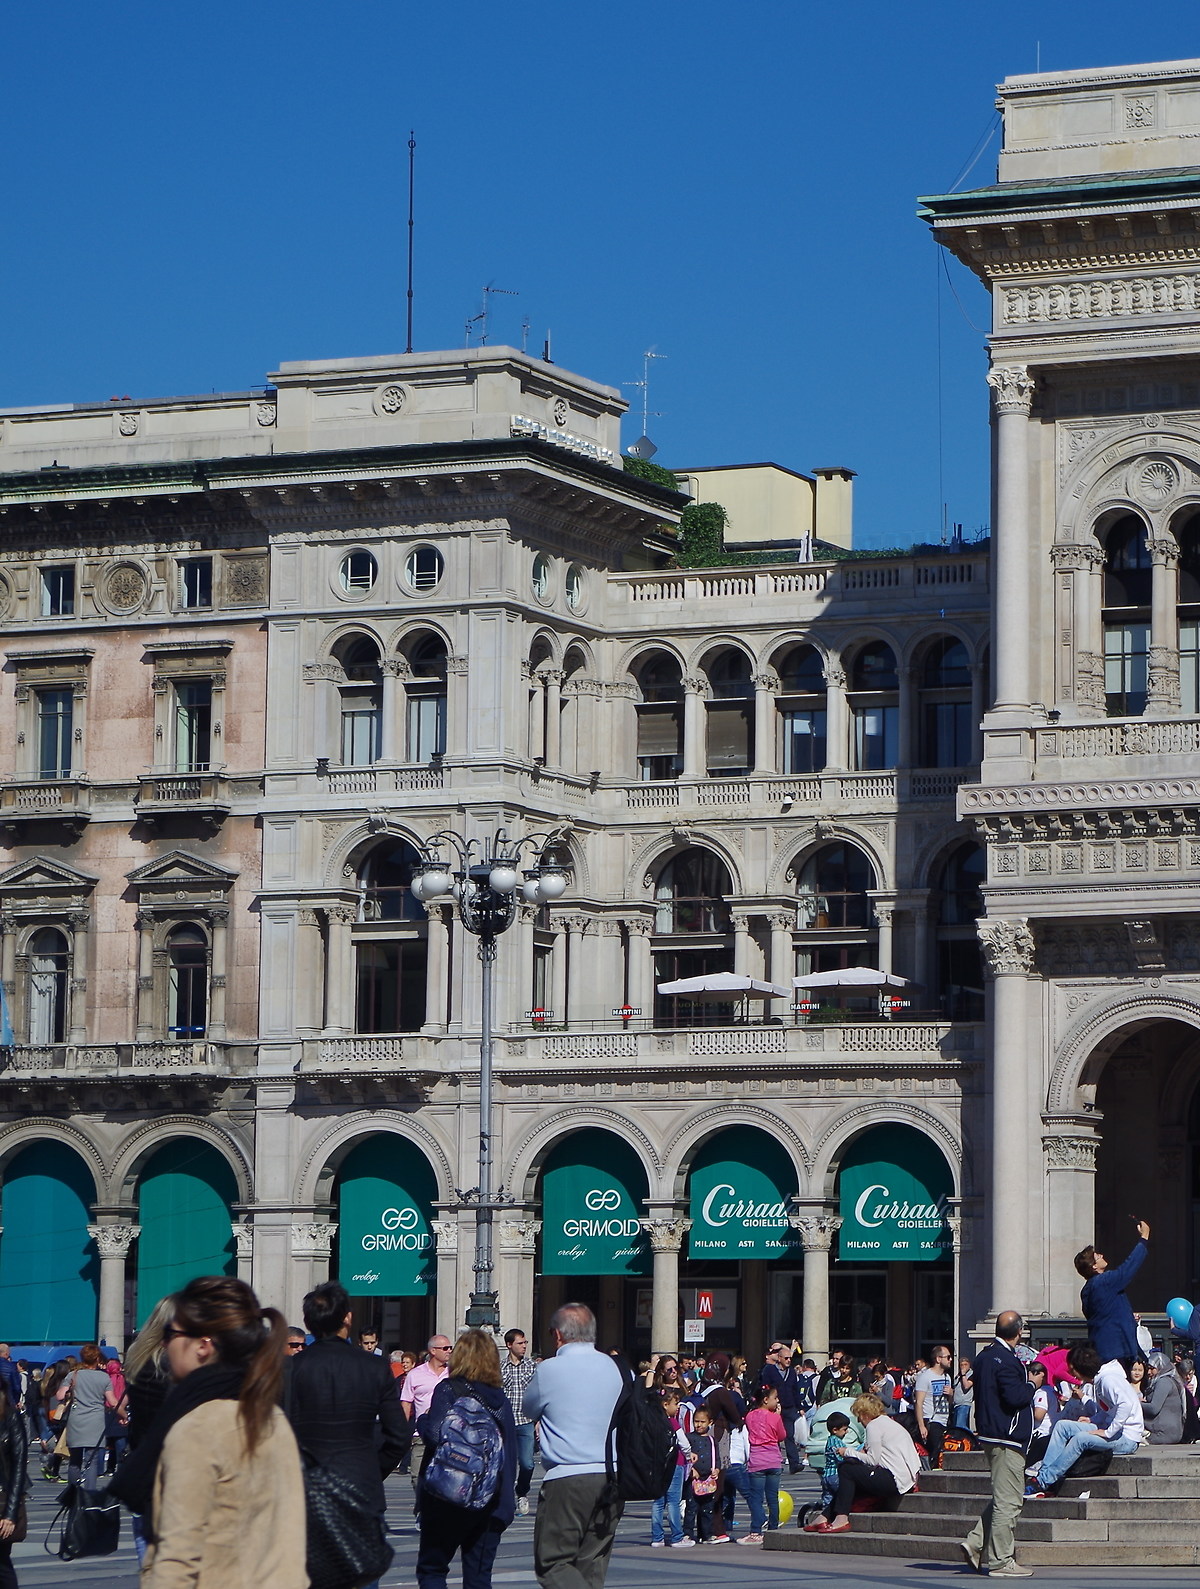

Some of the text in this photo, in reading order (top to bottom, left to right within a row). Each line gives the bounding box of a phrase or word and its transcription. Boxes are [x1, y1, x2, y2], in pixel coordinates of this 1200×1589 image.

[882, 1000, 910, 1008] MARTINI
[694, 1240, 727, 1248] MILANO
[738, 1240, 755, 1248] ASTI
[847, 1241, 880, 1249] MILANO
[892, 1241, 909, 1249] ASTI
[352, 1270, 381, 1284] orologi
[699, 1296, 711, 1312] M
